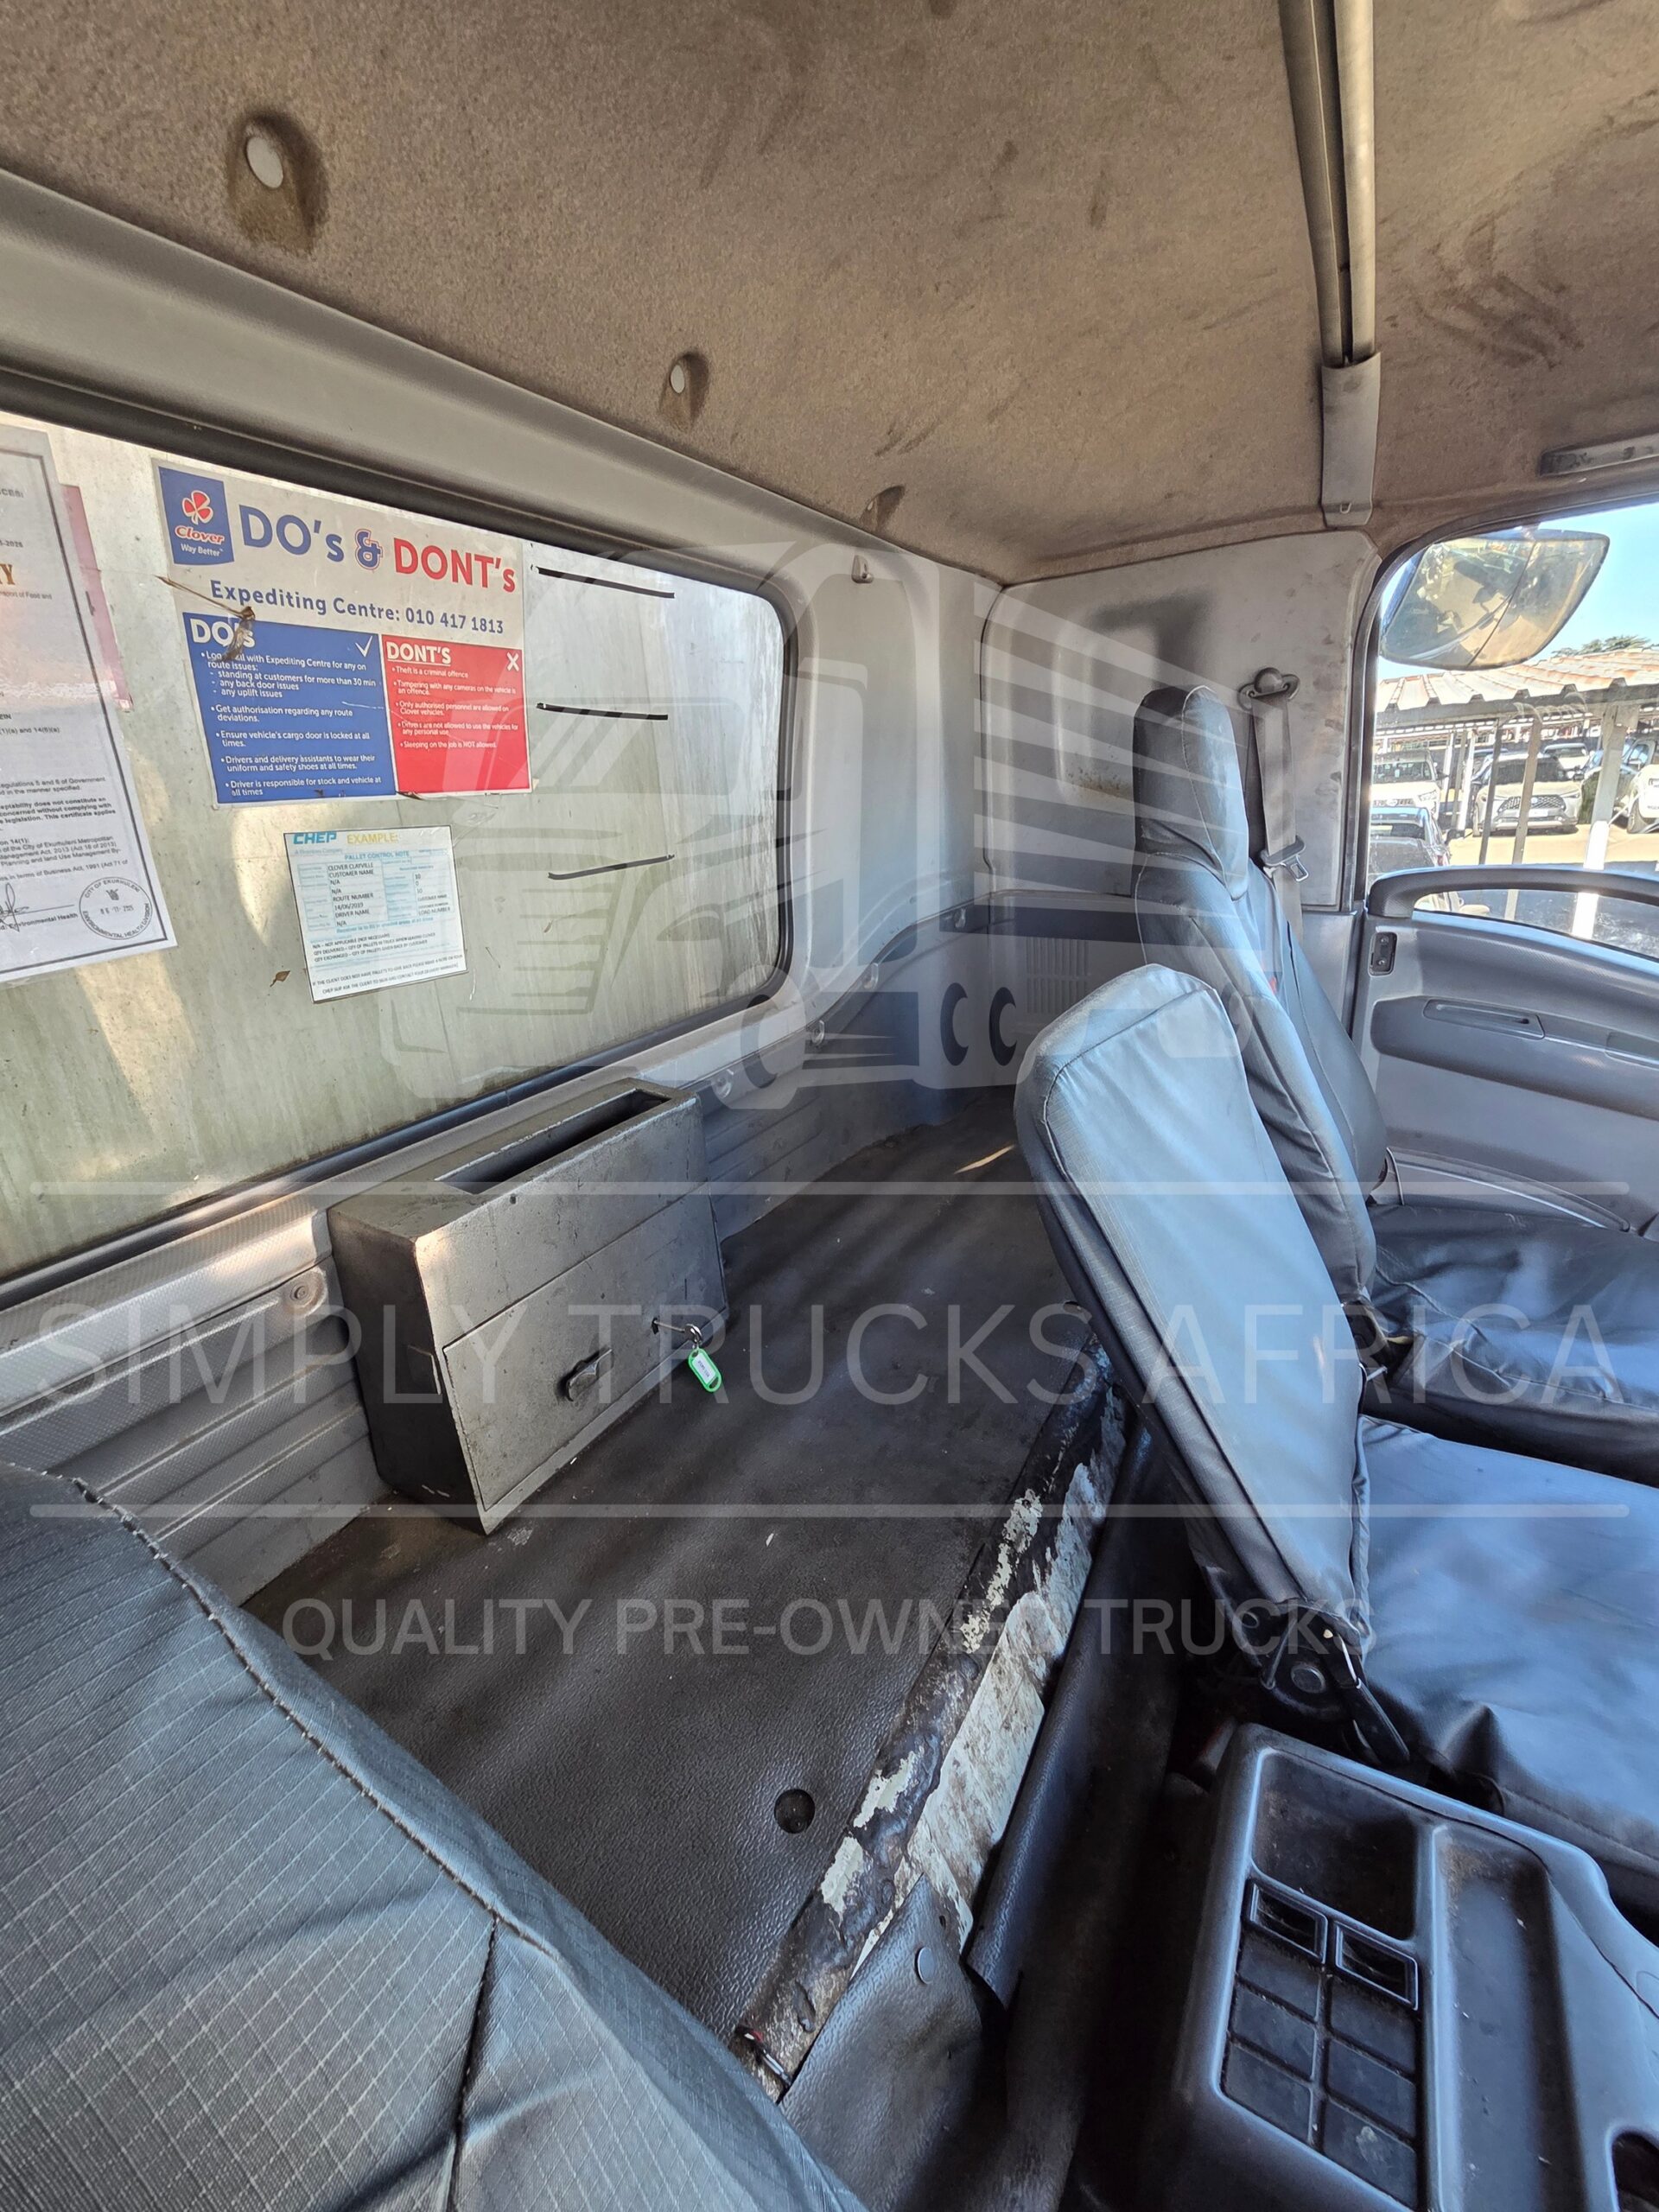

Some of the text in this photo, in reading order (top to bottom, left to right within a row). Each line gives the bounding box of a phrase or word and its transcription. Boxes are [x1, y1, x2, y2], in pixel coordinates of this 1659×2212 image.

[175, 525, 225, 545] Clover
[181, 543, 198, 555] Way
[238, 505, 517, 594] DO's & DONT's
[211, 580, 505, 634] Expediting Centre: 010 417 1813
[386, 641, 451, 665] DONT'S
[208, 661, 258, 671] route issues:
[246, 654, 264, 664] with
[266, 655, 306, 668] Expediting
[307, 658, 331, 668] Centre
[332, 660, 342, 669] for
[344, 663, 355, 671] any
[219, 671, 252, 681] standing
[264, 673, 303, 683] customers
[304, 675, 315, 683] for
[220, 679, 300, 690] any back door issues
[221, 689, 283, 698] any uplift issues
[216, 704, 232, 713] Get
[232, 705, 283, 715] authorisation
[285, 709, 319, 717] regarding
[217, 714, 260, 722] deviations.
[220, 730, 248, 739] Ensure
[249, 731, 282, 740] vehicle's
[270, 755, 299, 765] delivery
[300, 754, 334, 763] assistants
[360, 753, 376, 762] their
[227, 764, 258, 772] uniform
[276, 763, 296, 772] safety
[298, 762, 319, 771] shoes
[338, 761, 357, 770] times.
[231, 780, 254, 789] Driver
[264, 779, 304, 788] responsible
[318, 777, 336, 785] stock
[351, 776, 374, 785] vehicle
[232, 788, 241, 797] all
[294, 830, 398, 844] CHEP EXAMPLE:
